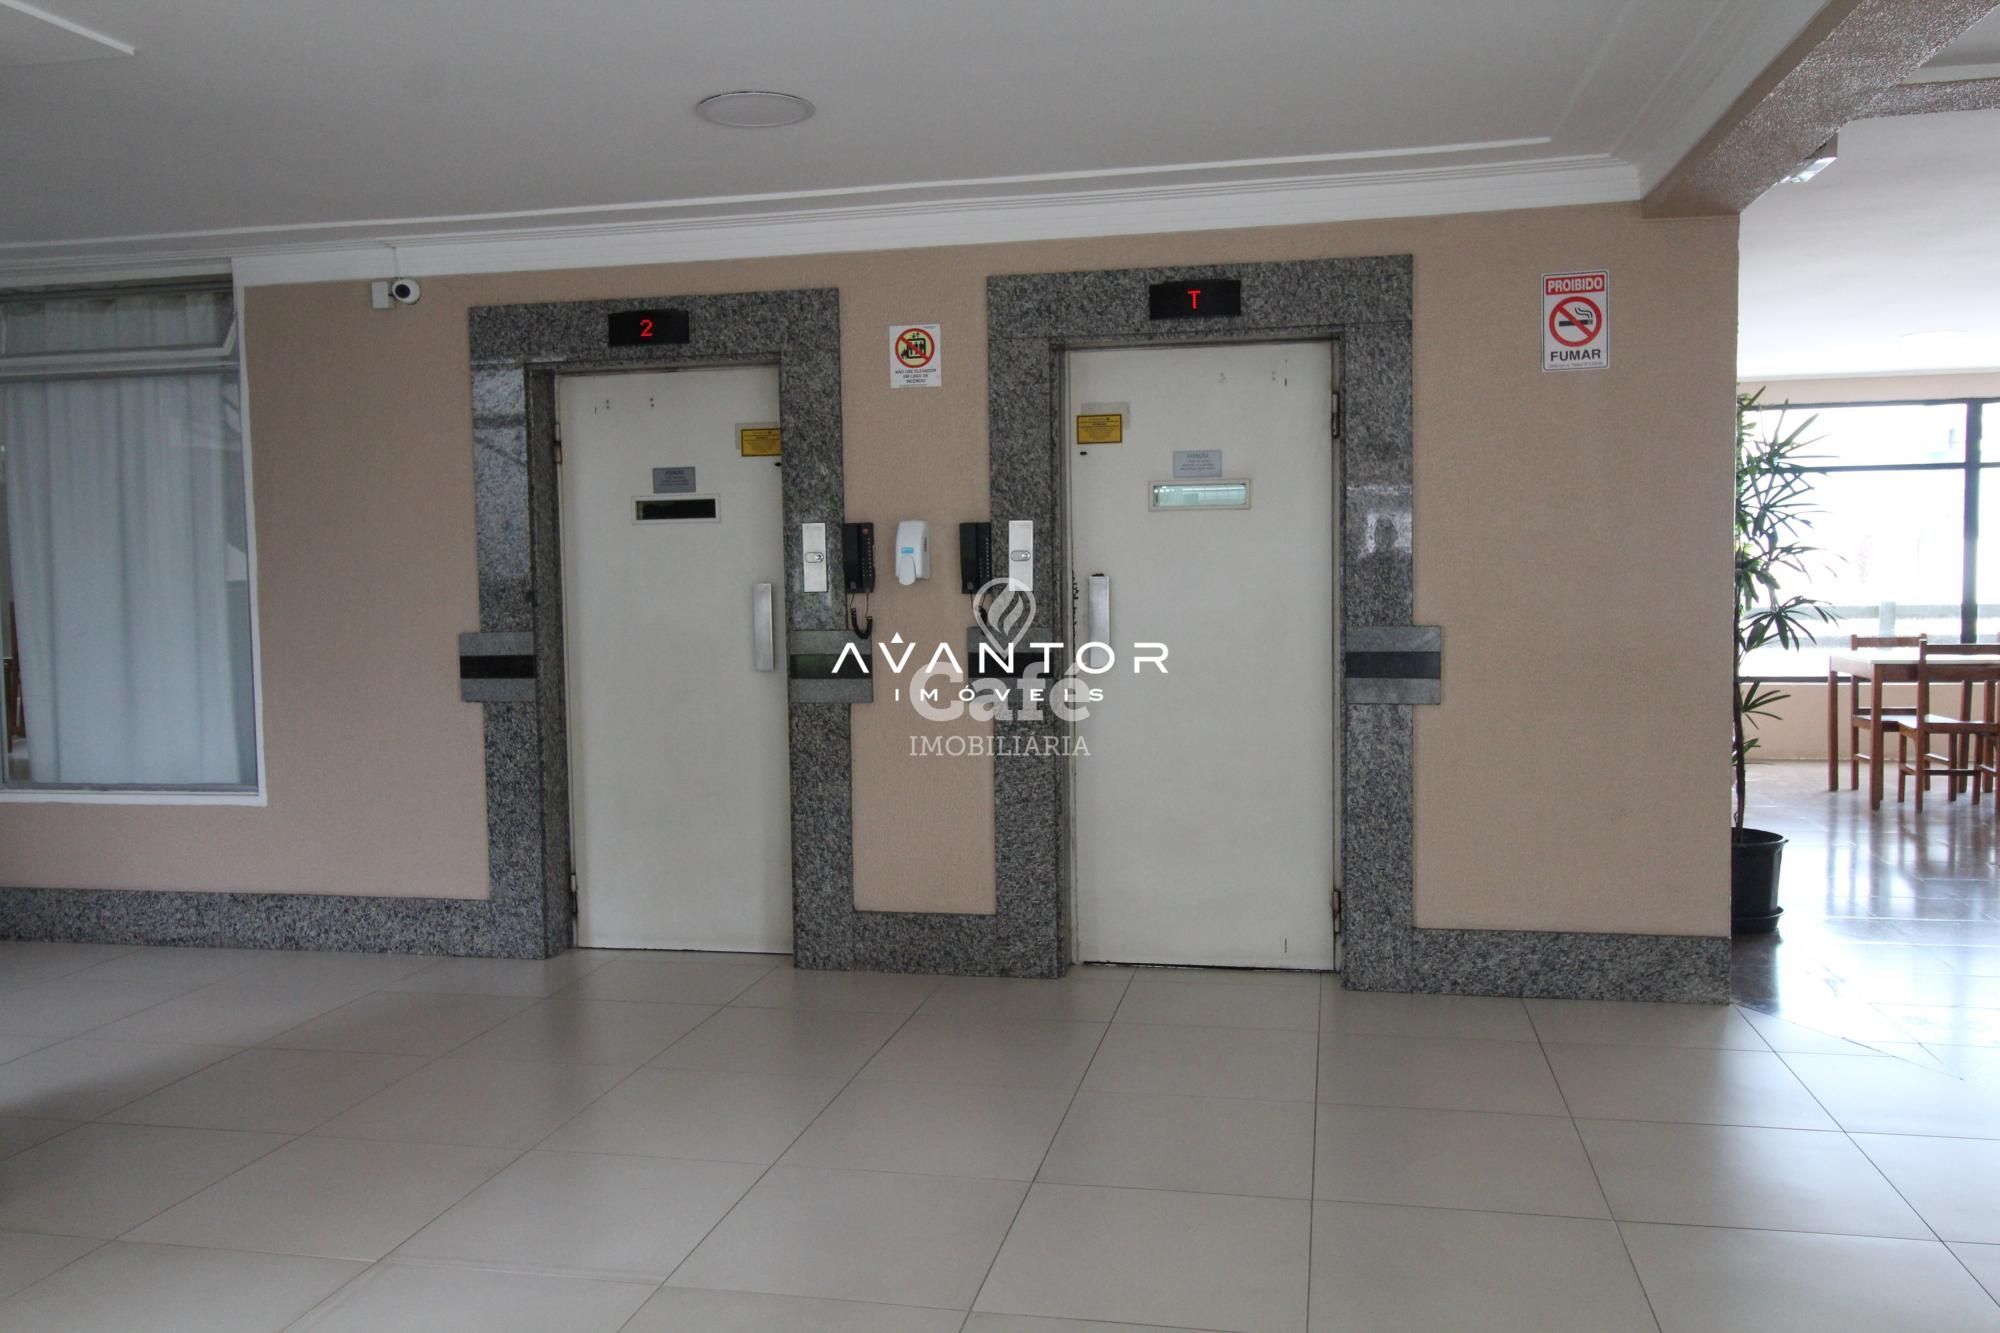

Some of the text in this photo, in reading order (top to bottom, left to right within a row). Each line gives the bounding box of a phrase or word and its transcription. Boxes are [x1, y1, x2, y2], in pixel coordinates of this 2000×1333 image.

[1547, 277, 1603, 293] PROIBIDO
[1187, 290, 1201, 310] T
[640, 319, 653, 337] 2
[1550, 349, 1602, 362] FUMAR
